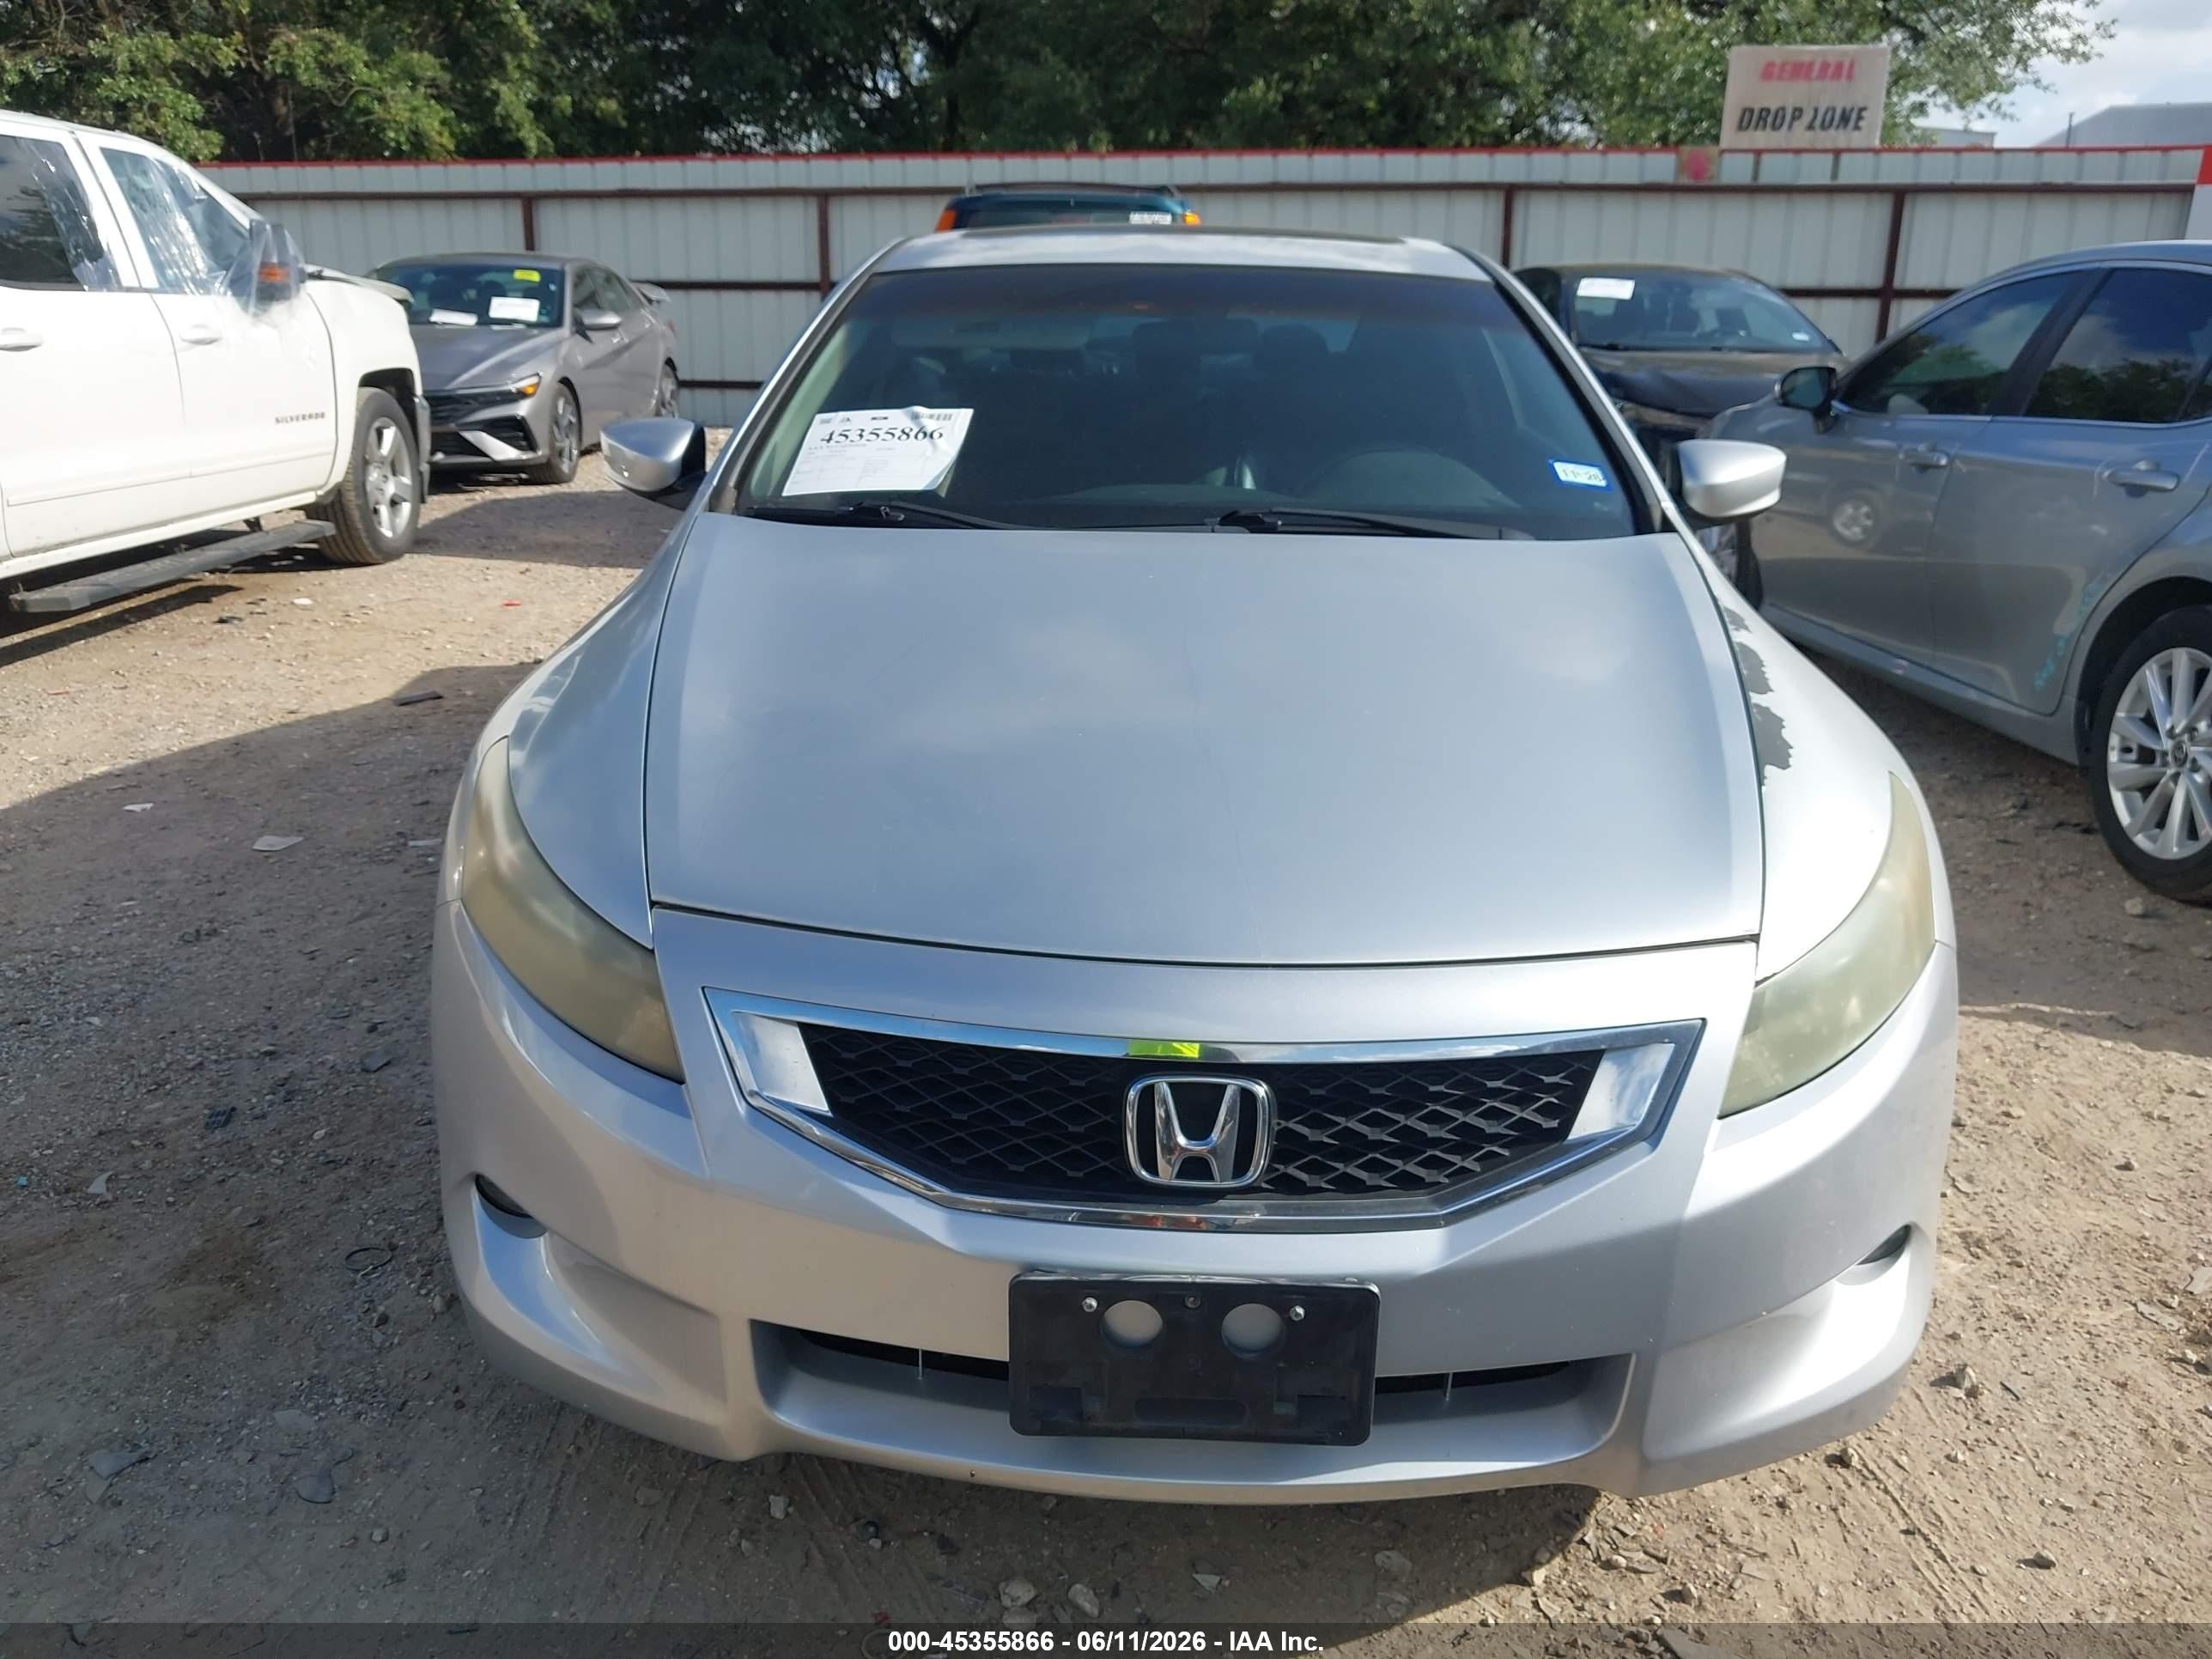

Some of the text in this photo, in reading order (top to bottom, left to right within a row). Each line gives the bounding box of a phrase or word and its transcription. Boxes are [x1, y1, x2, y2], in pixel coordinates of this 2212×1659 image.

[1761, 59, 1855, 81] GENERAL
[1737, 106, 1867, 131] DROP ZONE
[275, 411, 325, 423] SILVERADO
[820, 426, 944, 444] 45355866
